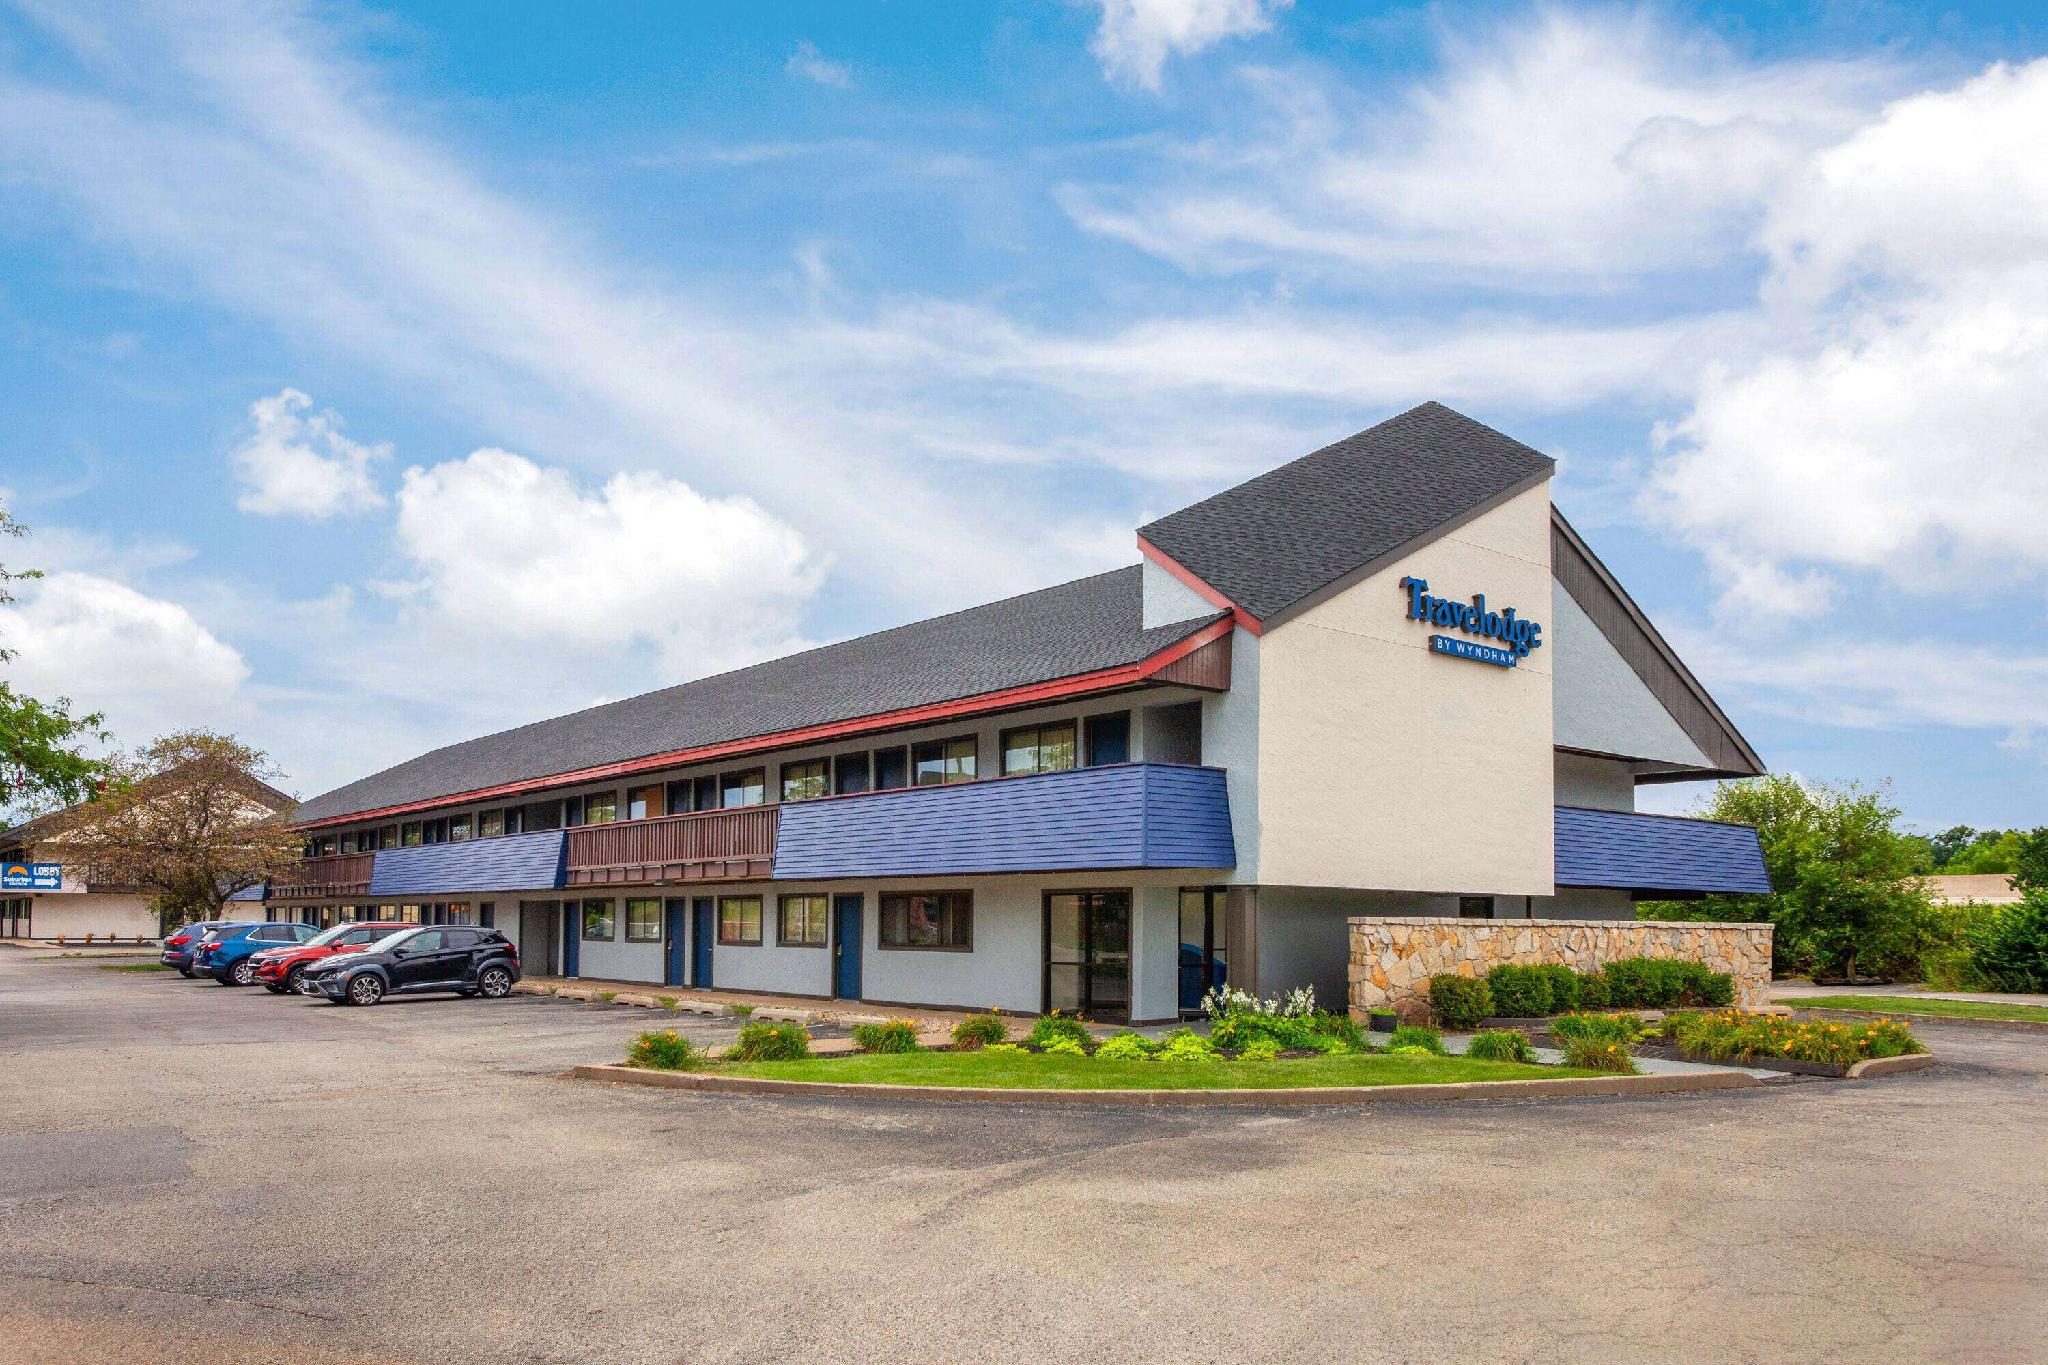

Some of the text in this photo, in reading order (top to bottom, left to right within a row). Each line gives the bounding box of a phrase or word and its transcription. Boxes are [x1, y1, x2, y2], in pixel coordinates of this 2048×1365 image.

[1399, 576, 1542, 658] Travelodge
[1437, 638, 1516, 664] BY WYNDHAM
[33, 866, 61, 876] LOBBY
